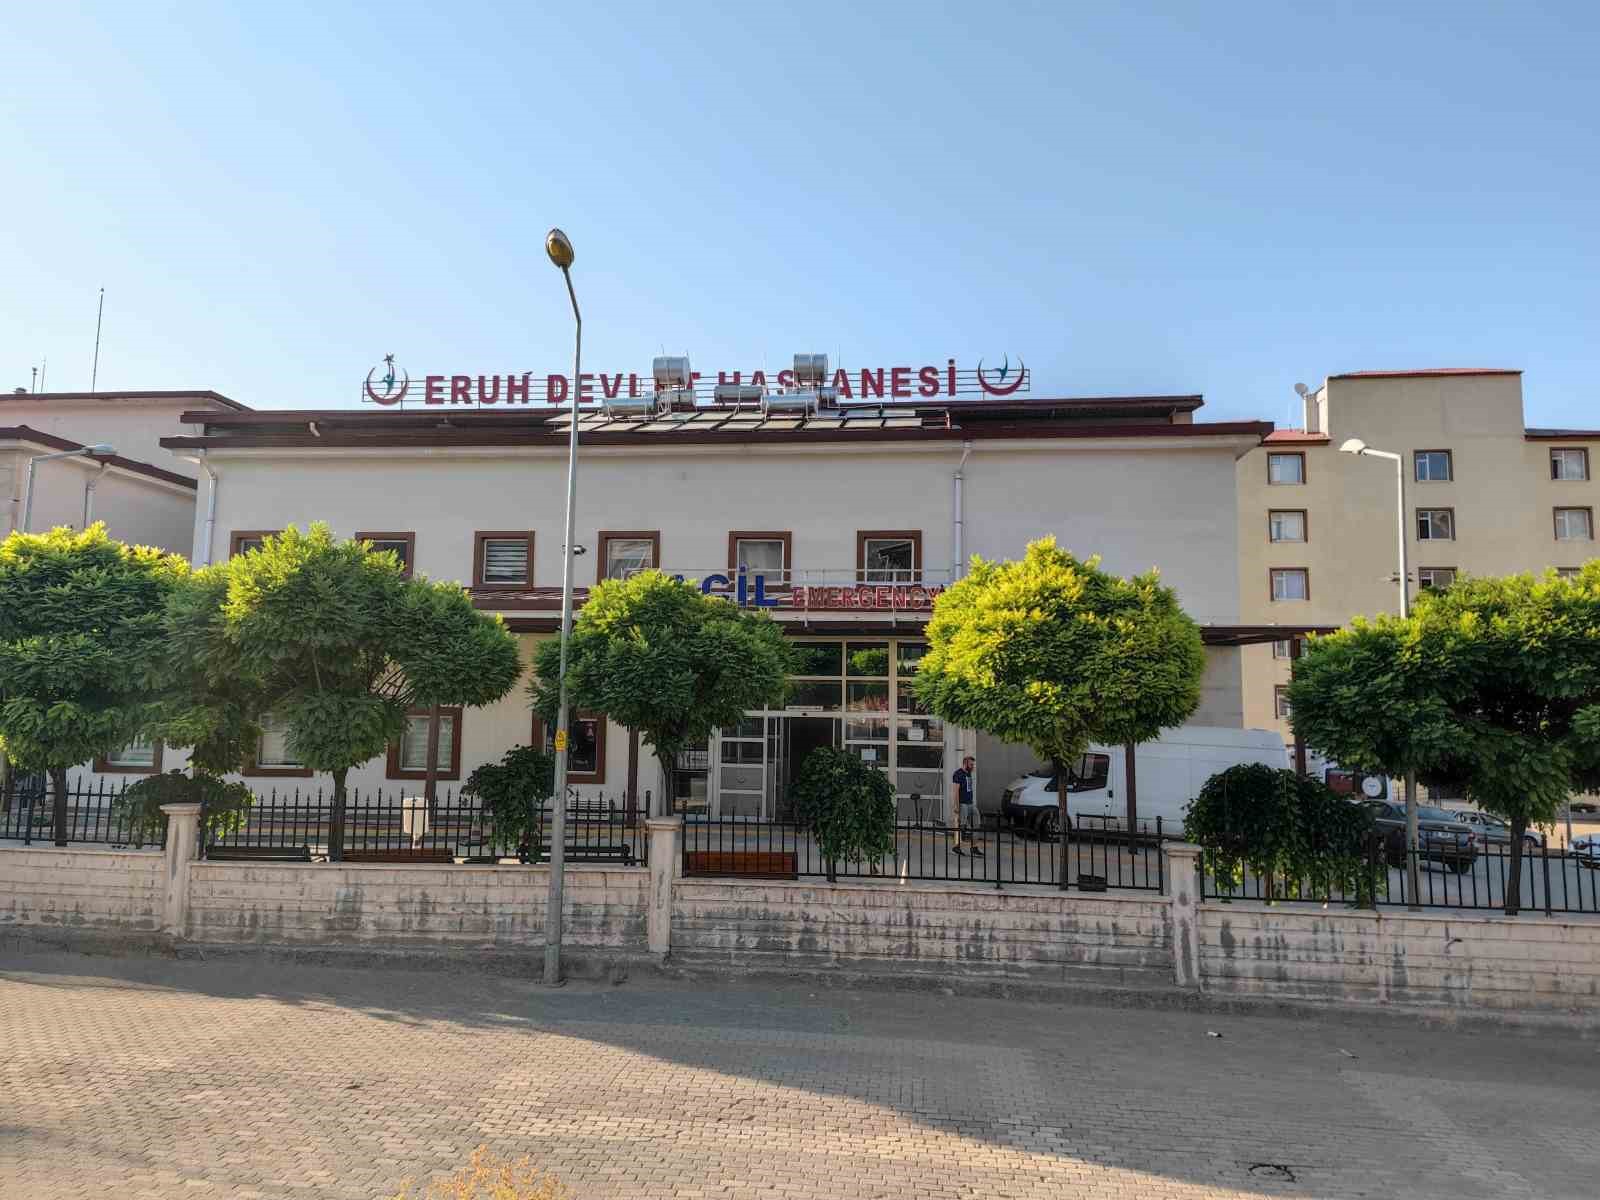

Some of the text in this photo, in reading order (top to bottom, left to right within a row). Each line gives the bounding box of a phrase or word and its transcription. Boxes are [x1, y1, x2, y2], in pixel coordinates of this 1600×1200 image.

[424, 358, 957, 405] ERUH DEVLT HASANESİ
[674, 566, 779, 608] CİL
[791, 585, 944, 609] EMERGENCY
